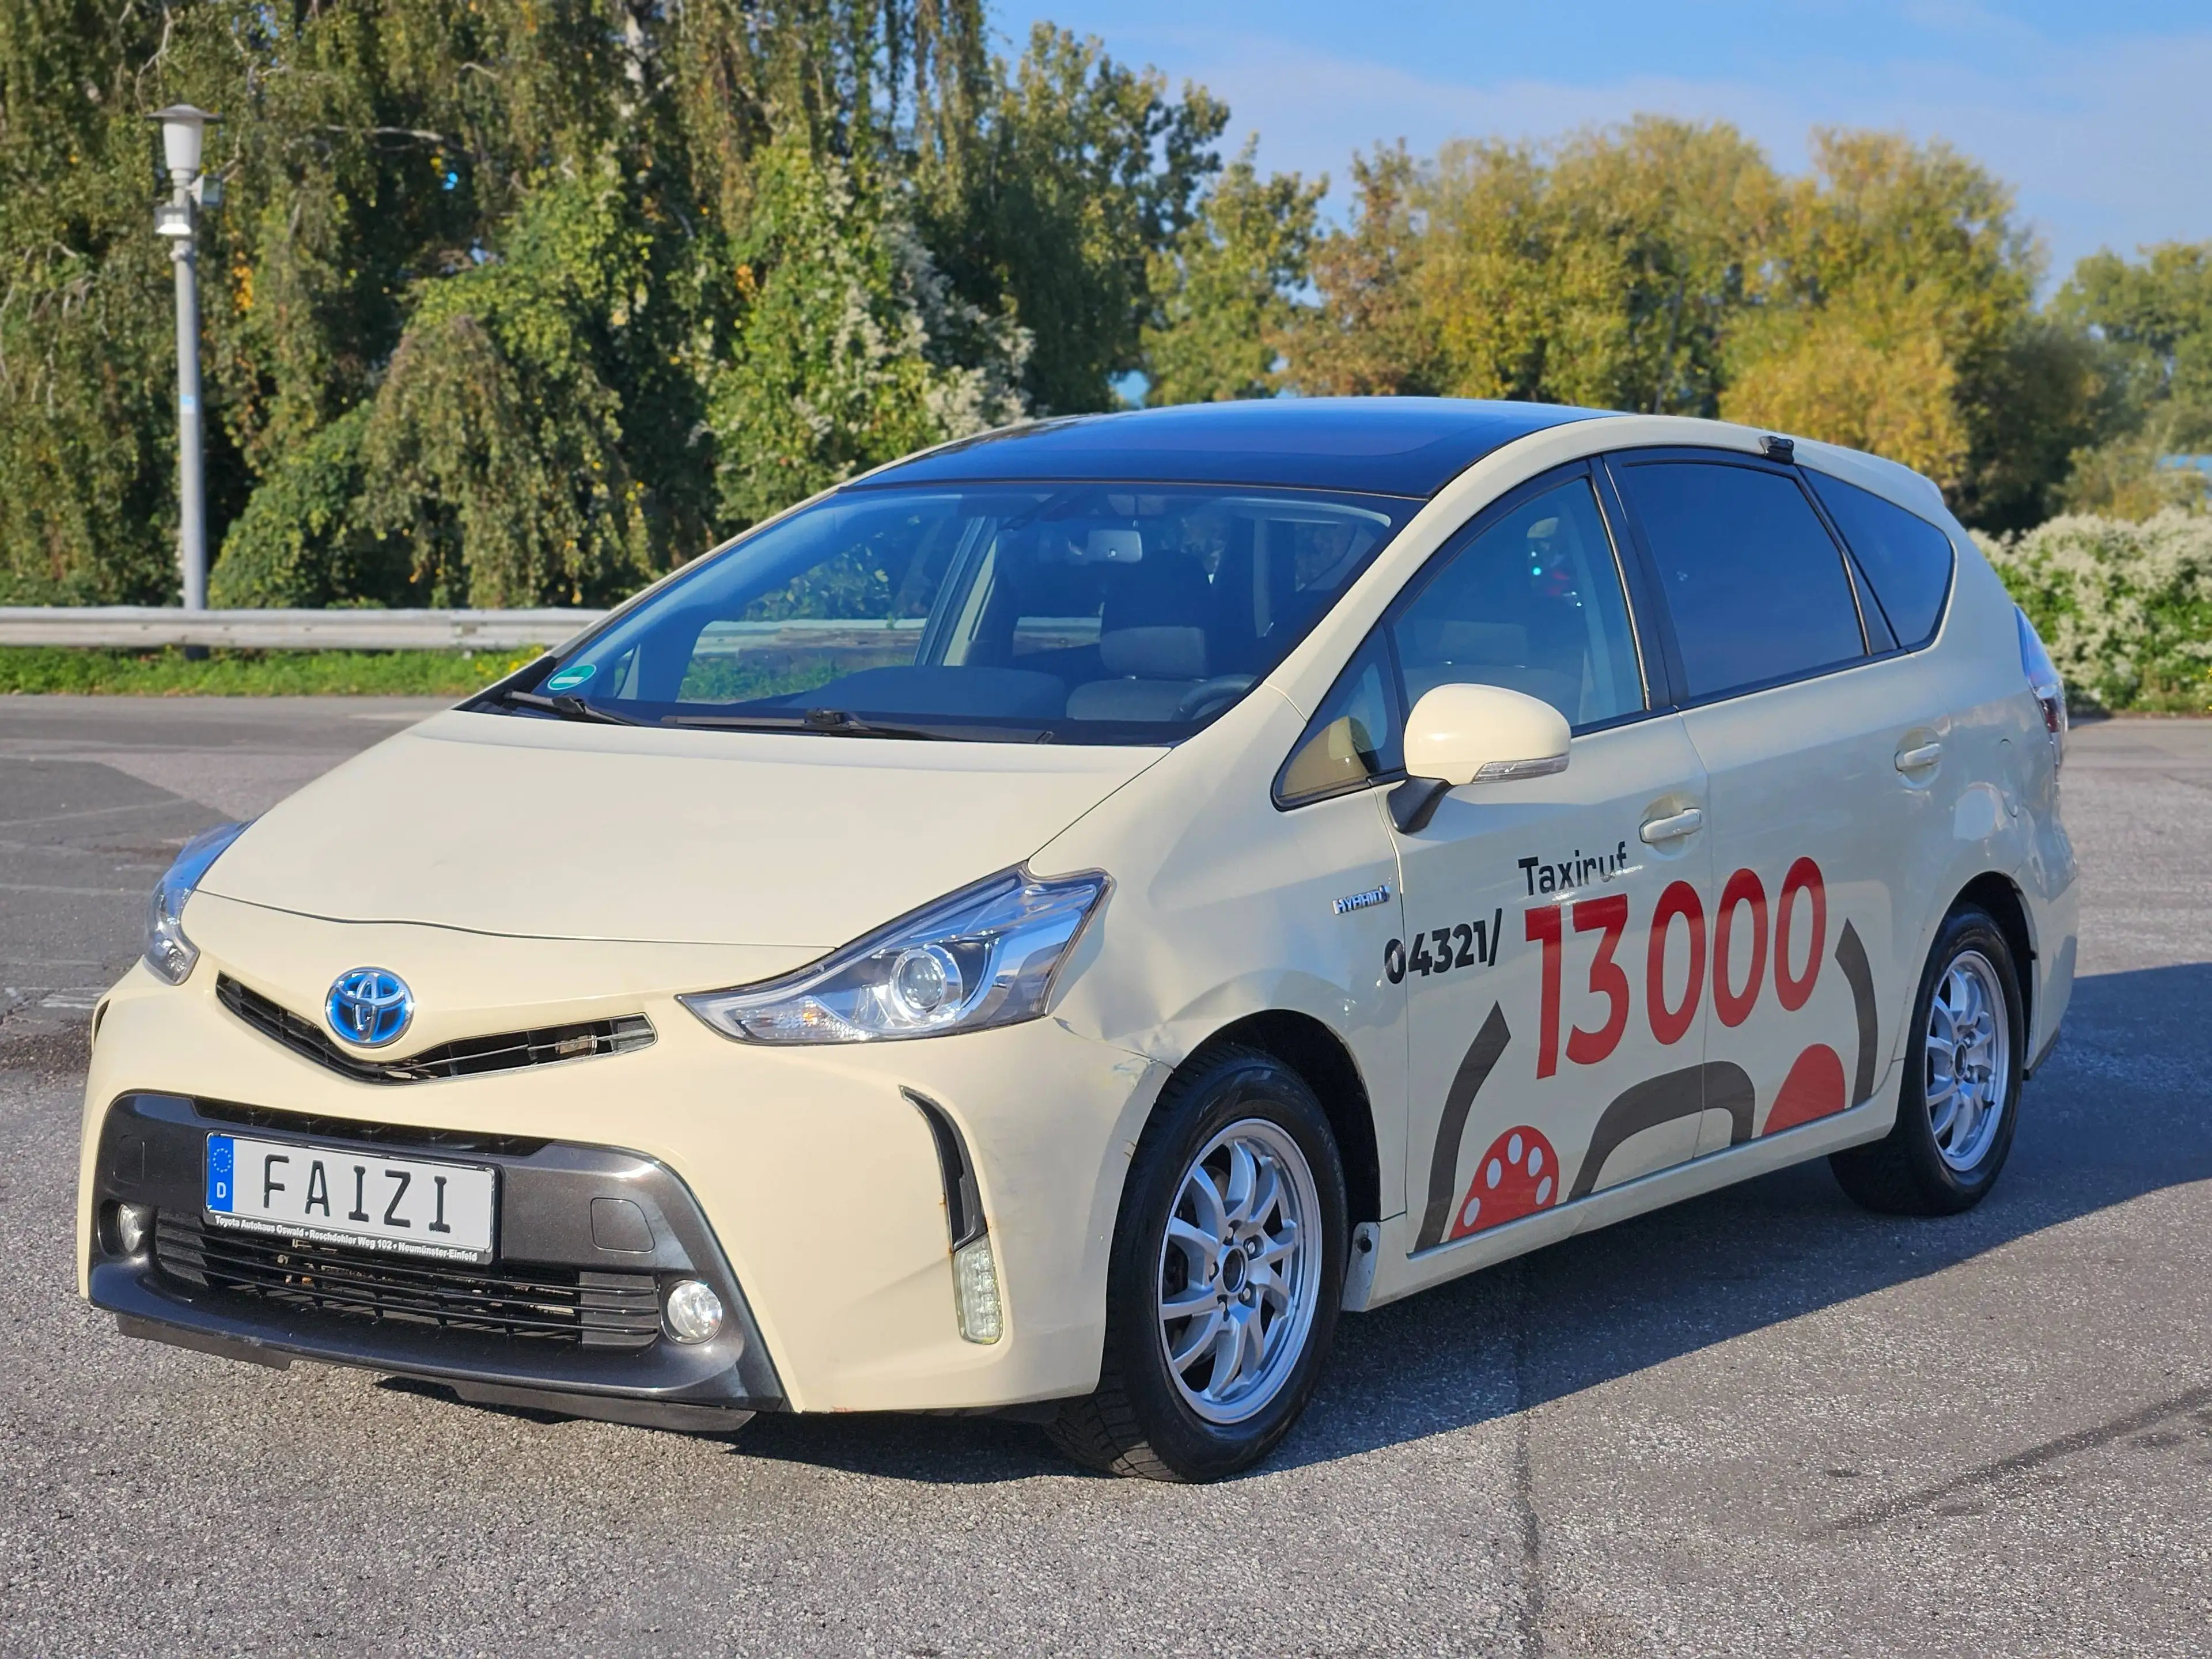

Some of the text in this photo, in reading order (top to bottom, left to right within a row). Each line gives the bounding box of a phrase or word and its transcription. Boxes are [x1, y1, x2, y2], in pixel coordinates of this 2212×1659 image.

[1518, 841, 1627, 896] Taxiruf
[1384, 907, 1502, 984] 04321/
[216, 1181, 226, 1199] D
[263, 1154, 450, 1234] FAIZI
[215, 1215, 478, 1262] Toyota Autohaus Oswald Roschdohler Weg 102 Neumünster-Einfeld
